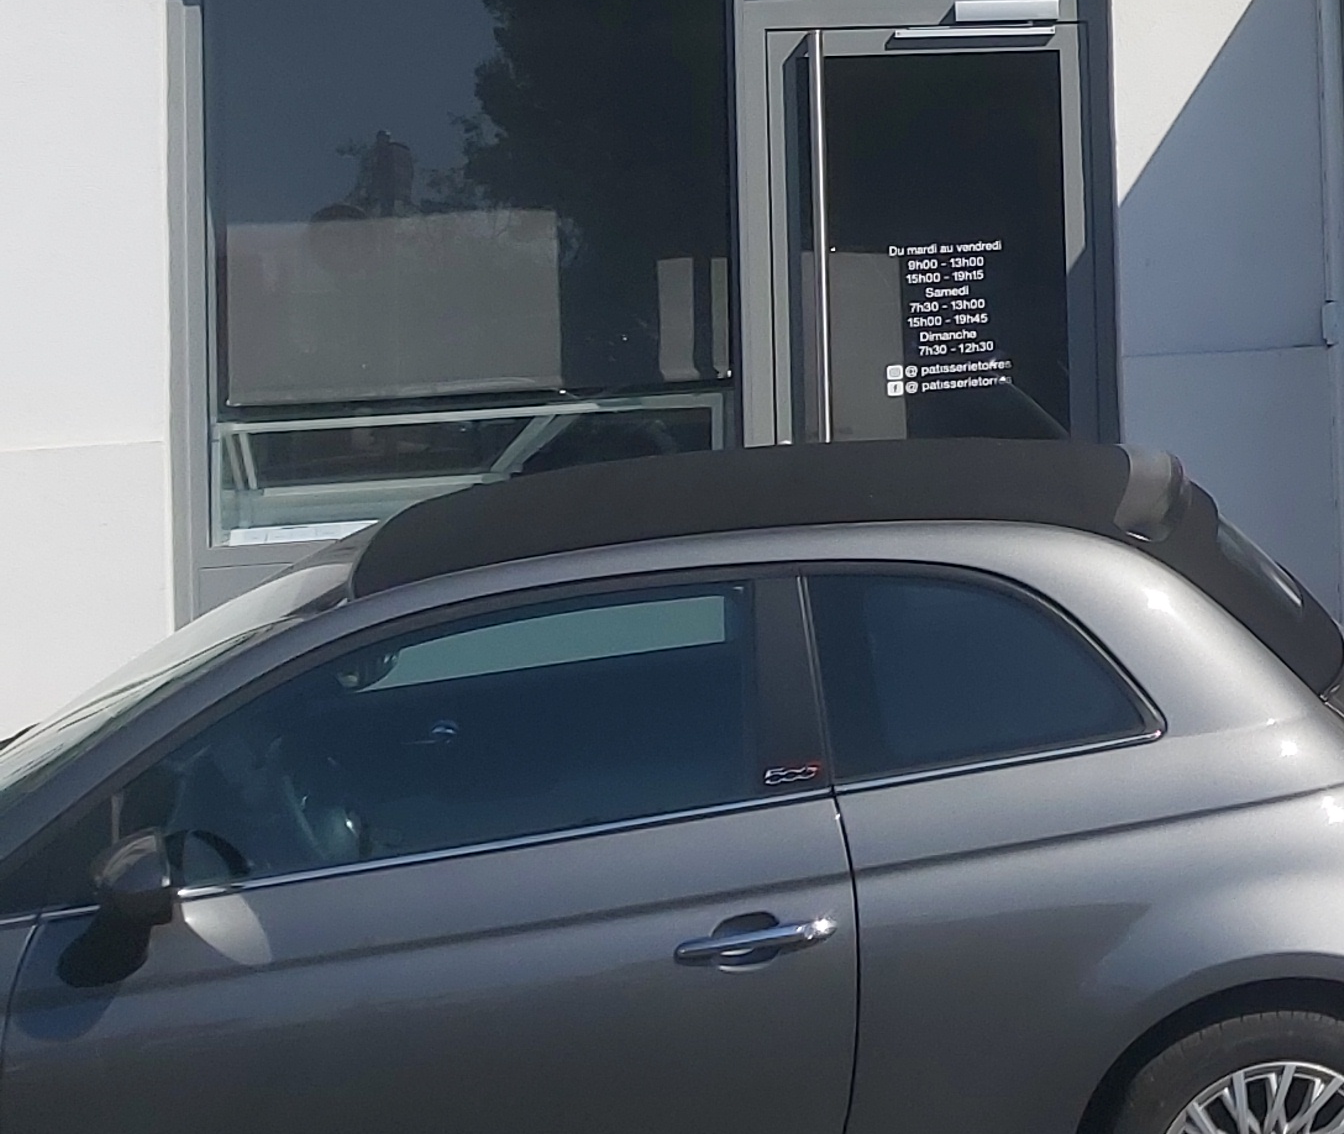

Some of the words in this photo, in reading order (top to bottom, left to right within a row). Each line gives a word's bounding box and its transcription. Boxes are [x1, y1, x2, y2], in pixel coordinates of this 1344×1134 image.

[888, 245, 904, 256] Du
[906, 243, 937, 255] mardi
[939, 244, 953, 253] au
[956, 240, 1002, 253] vendredi
[907, 259, 938, 271] 9h00
[950, 256, 984, 268] 13h00
[906, 272, 941, 284] 15h00
[952, 269, 984, 282] 19h15
[925, 285, 969, 298] Samedi
[909, 301, 939, 313] 7h30
[951, 299, 986, 311] 13h00
[907, 316, 942, 327] 15h00
[953, 313, 989, 325] 19h45
[919, 329, 977, 342] Dimanche
[918, 344, 947, 356] 7h30
[958, 341, 994, 354] 12h30
